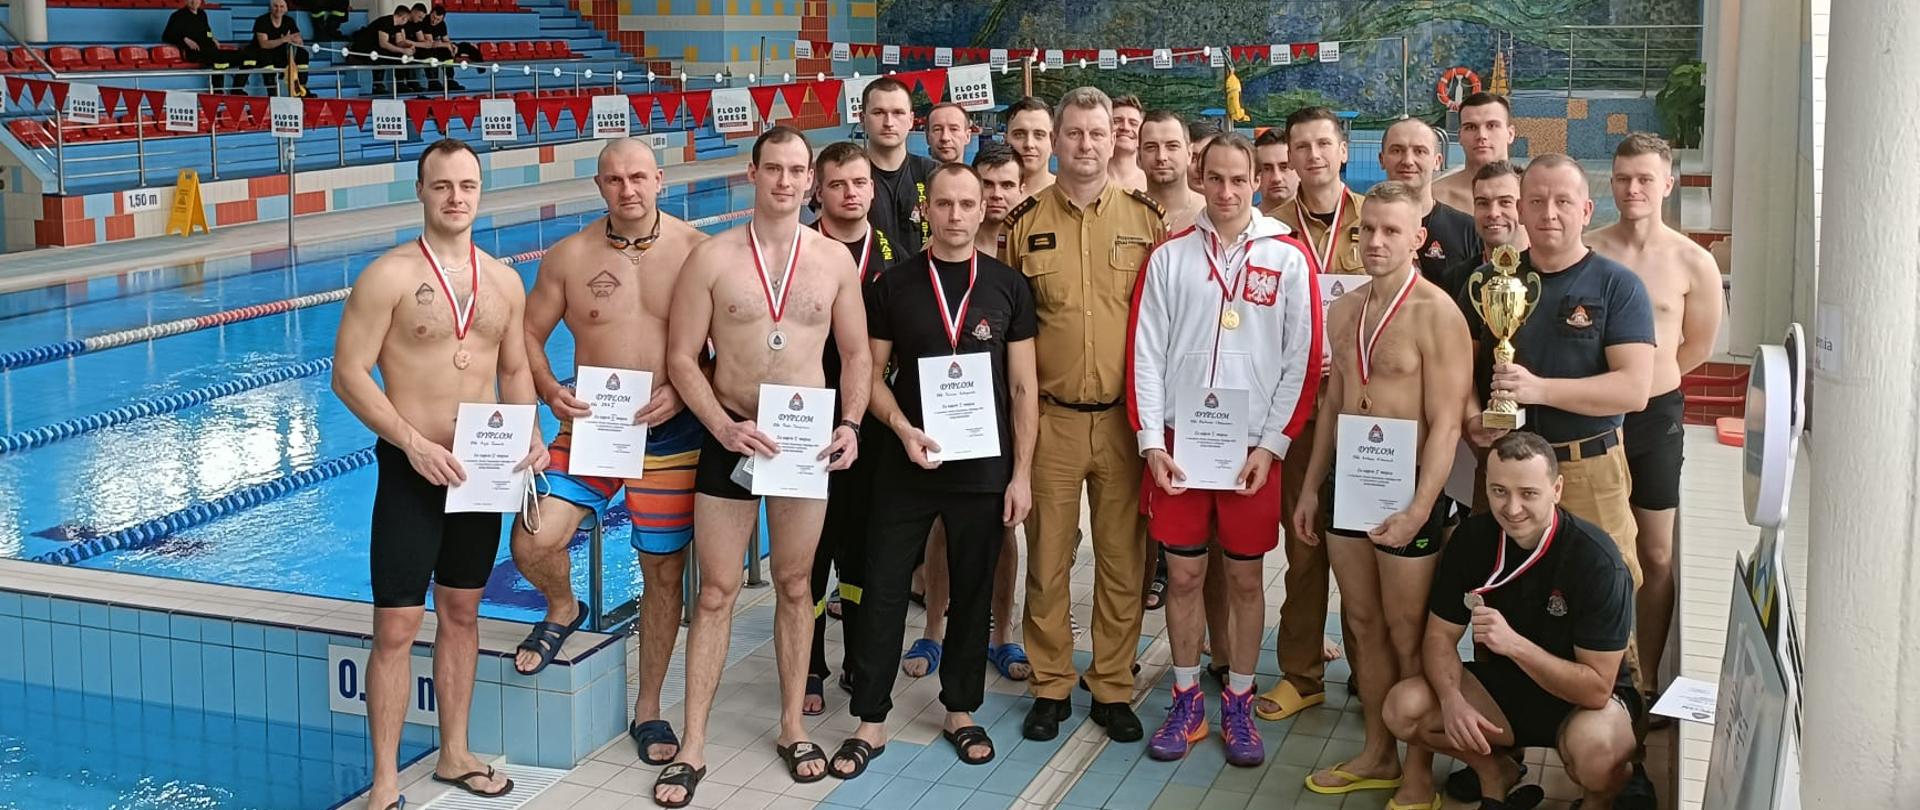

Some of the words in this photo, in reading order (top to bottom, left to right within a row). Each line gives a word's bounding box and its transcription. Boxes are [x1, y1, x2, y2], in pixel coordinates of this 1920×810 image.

[955, 83, 987, 93] FLOOR
[956, 93, 980, 101] GRES
[73, 99, 95, 107] FLOOR
[717, 106, 747, 114] FLOOR
[718, 114, 740, 122] GRES
[598, 120, 619, 128] GRES
[129, 194, 147, 208] 1,50
[149, 194, 157, 205] m
[940, 380, 974, 390] DYPLOM
[595, 393, 631, 403] DYPLOM
[778, 413, 814, 423] DYPLOM
[1194, 411, 1230, 420] DYPLOM
[476, 431, 514, 440] DYPLOM
[1358, 445, 1395, 456] DYPLOM
